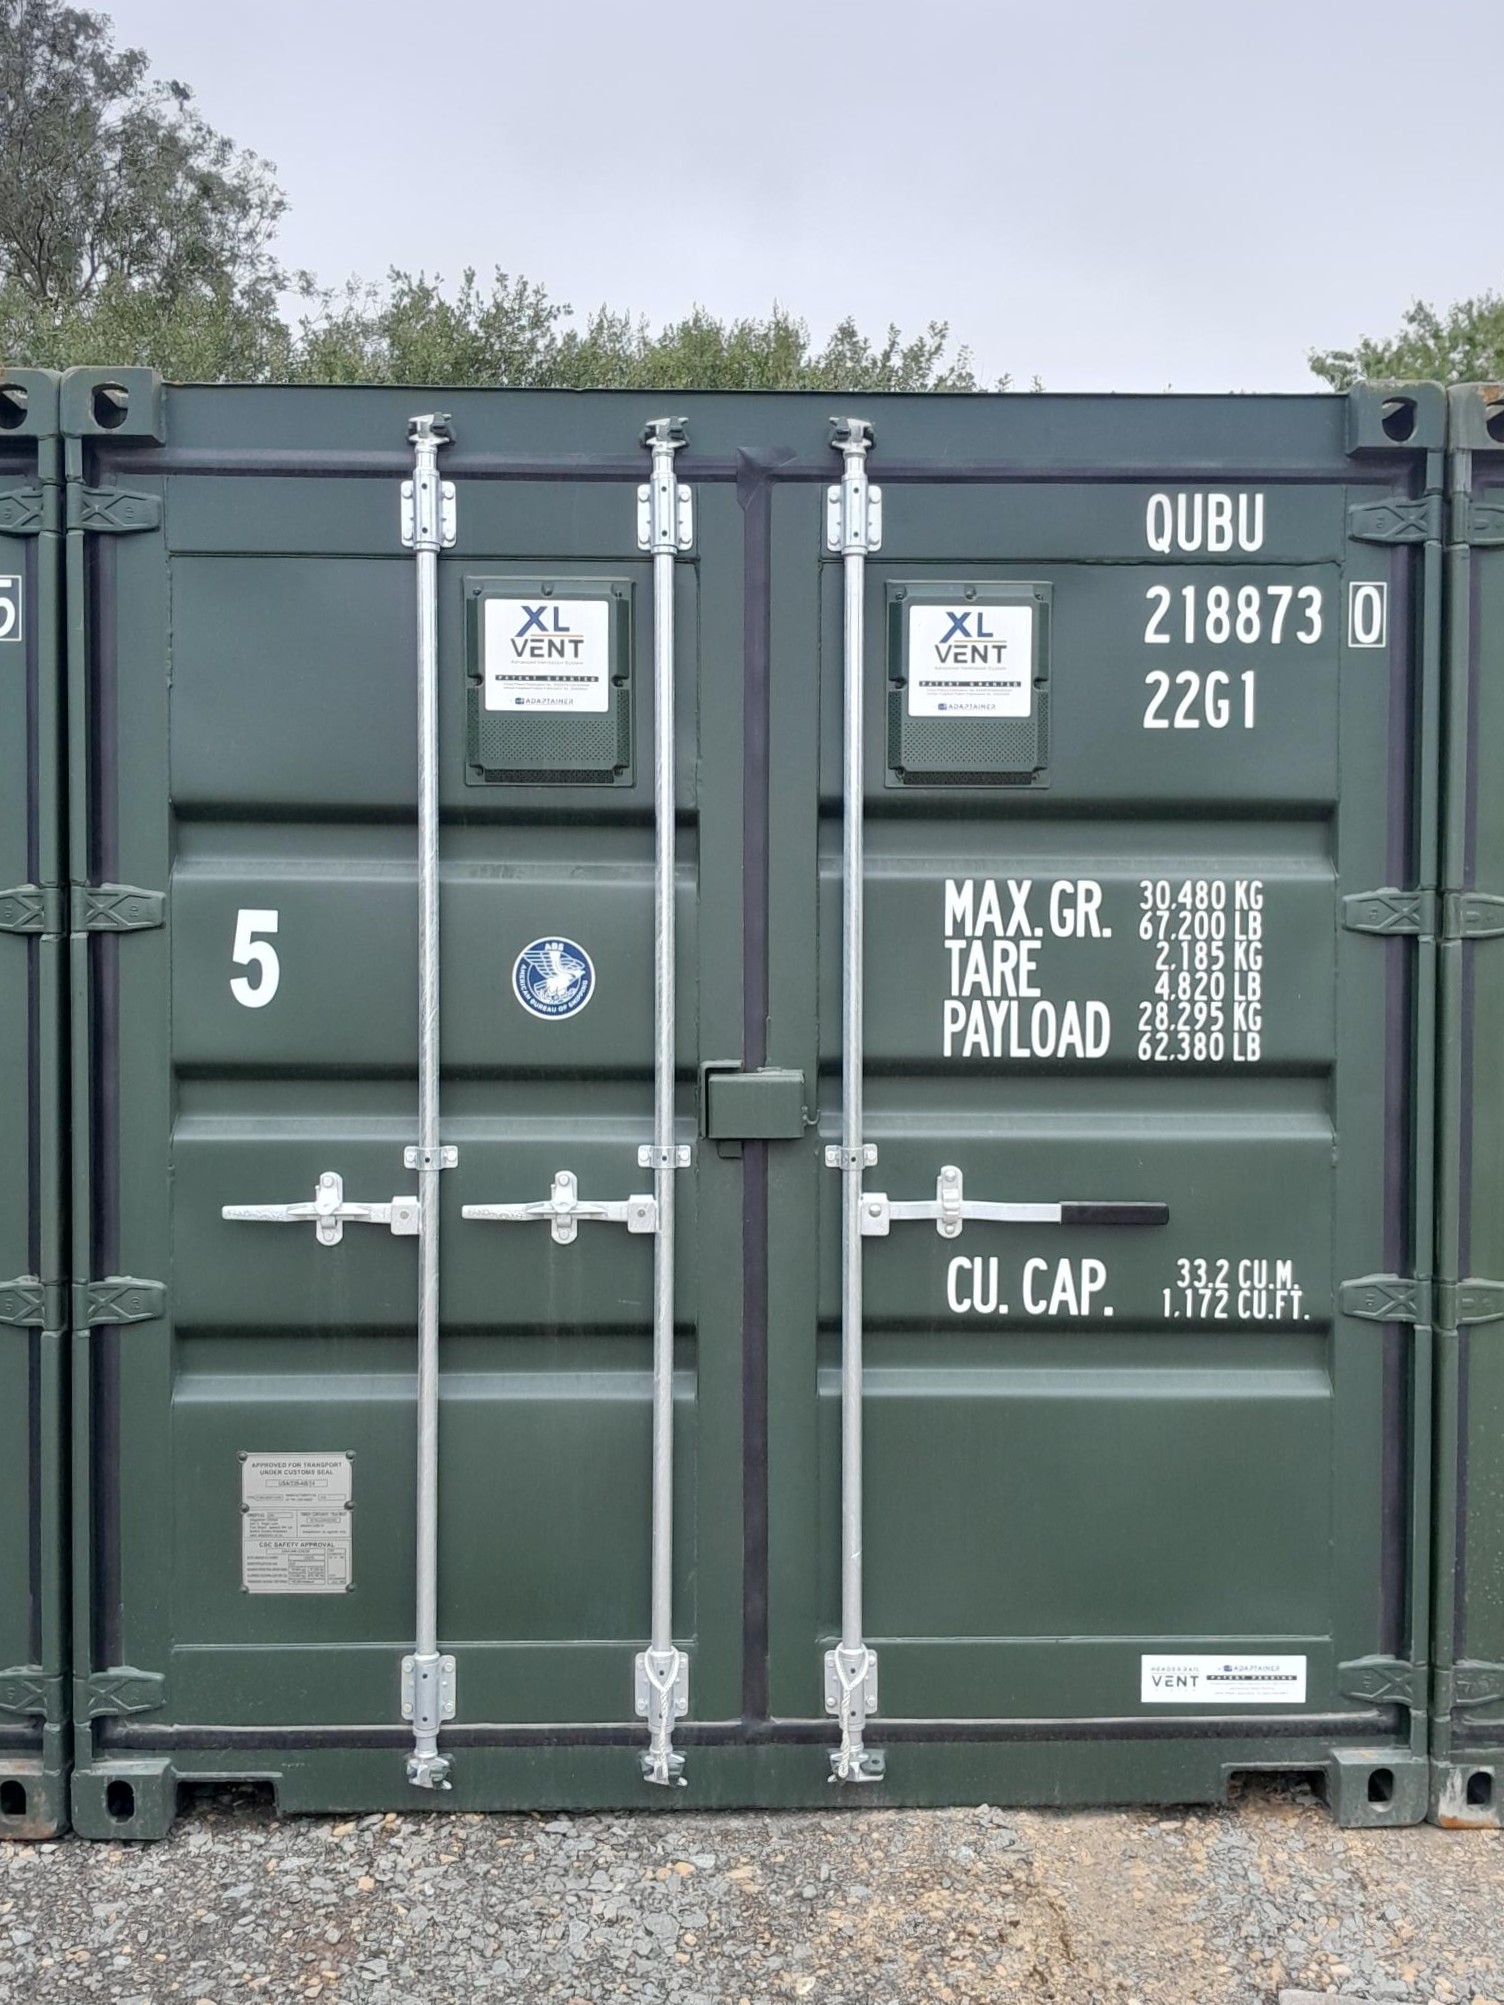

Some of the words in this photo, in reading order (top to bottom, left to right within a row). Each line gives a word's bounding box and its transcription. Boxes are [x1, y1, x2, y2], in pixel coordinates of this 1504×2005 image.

[1146, 493, 1264, 554] QUBU
[515, 605, 570, 637] XL
[939, 611, 993, 643] XL
[1144, 585, 1323, 644] 218873
[1354, 586, 1382, 644] 0
[511, 638, 584, 658] VENT
[934, 644, 1007, 664] VENT
[1143, 670, 1255, 729] 22G1
[945, 879, 1043, 937] MAX.
[1050, 880, 1112, 937] GR.
[1139, 880, 1226, 911] 30,480
[1235, 880, 1263, 911] KG
[1139, 911, 1226, 941] 67,200
[1234, 911, 1262, 941] LB
[230, 909, 280, 1009] 5
[544, 942, 565, 951] ABS
[1155, 941, 1225, 971] 2,185
[1234, 941, 1262, 971] KG
[945, 940, 1042, 997] TARE
[519, 963, 532, 1001] AMERICAN
[529, 998, 557, 1013] BUREAU
[558, 1004, 568, 1012] OF
[1154, 971, 1225, 1001] 4,820
[1233, 971, 1262, 1001] LB
[943, 1000, 1111, 1058] PAYLOAD
[1138, 1001, 1225, 1031] 28,295
[1233, 1001, 1262, 1031] KG
[1138, 1031, 1225, 1062] 62,380
[1233, 1032, 1261, 1062] LB
[947, 1256, 1009, 1314] CU.
[1022, 1257, 1114, 1316] CAP.
[1176, 1258, 1230, 1288] 33.2
[1238, 1259, 1300, 1289] CU.M.
[1162, 1288, 1229, 1318] 1,172
[1237, 1289, 1310, 1320] CU.FT.
[1152, 1675, 1199, 1687] VENT
